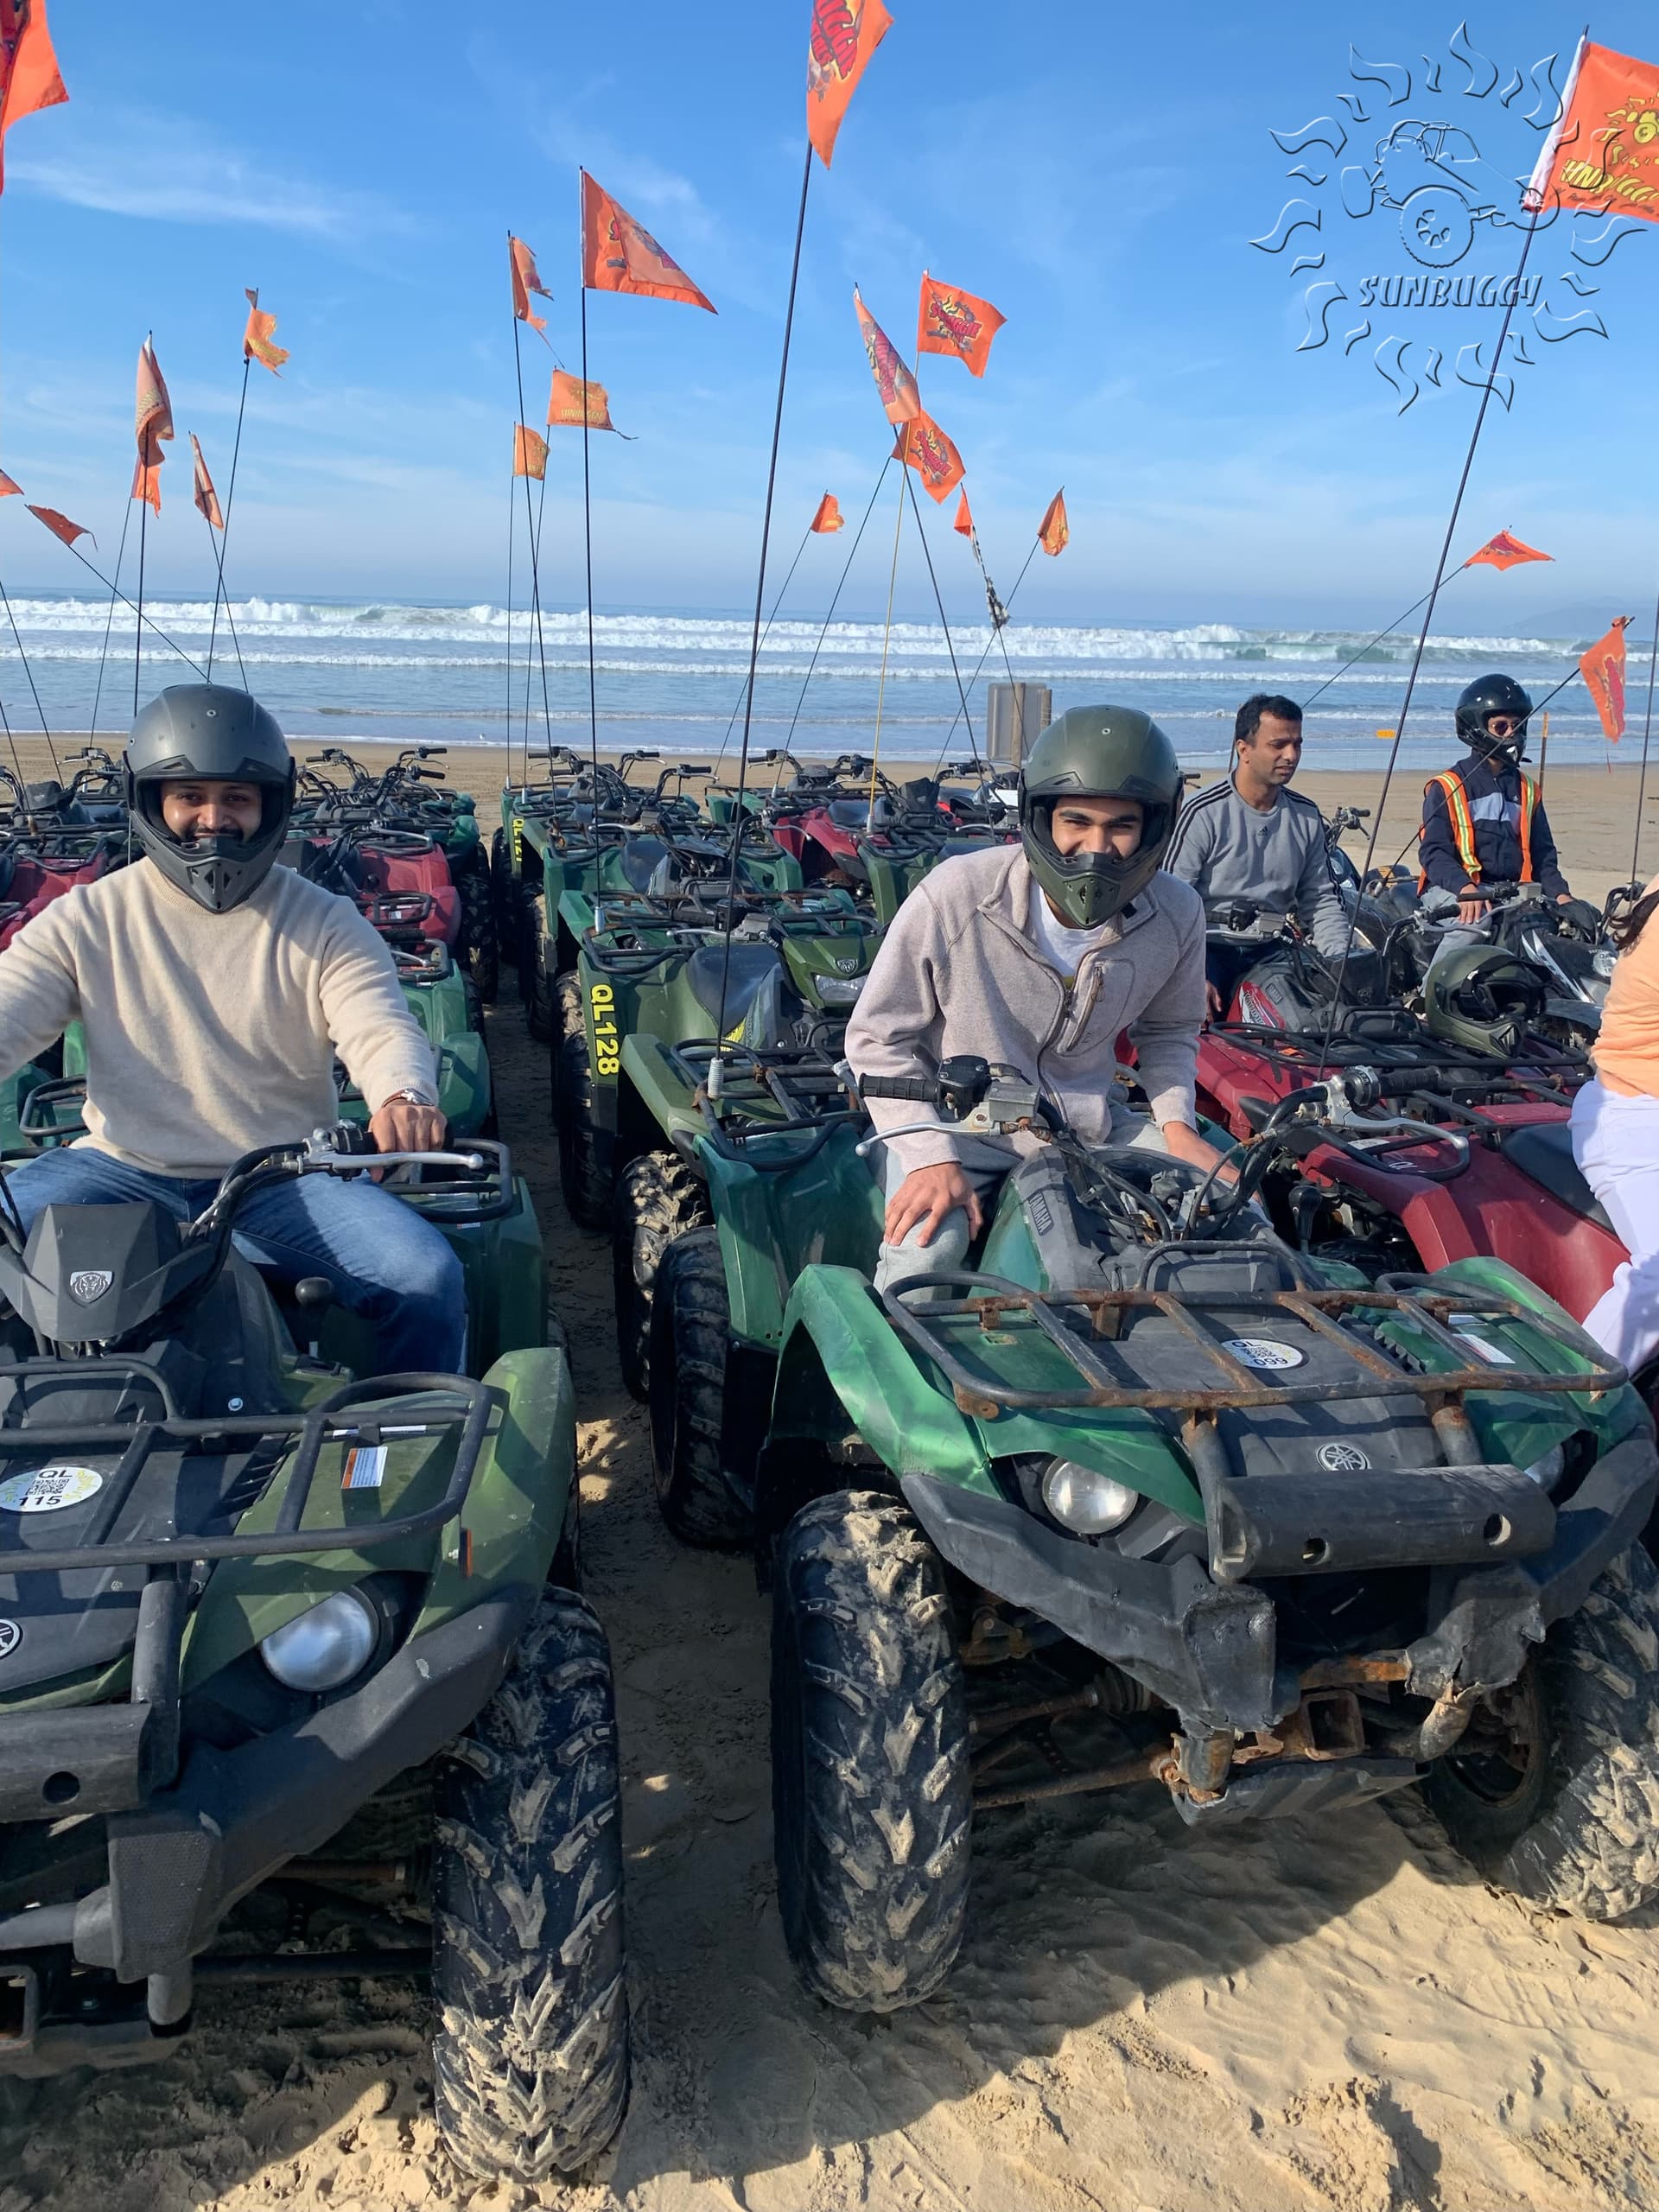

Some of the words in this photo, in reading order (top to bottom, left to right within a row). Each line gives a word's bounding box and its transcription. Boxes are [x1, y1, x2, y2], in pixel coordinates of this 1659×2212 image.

[590, 983, 620, 1076] QL128
[1253, 1357, 1288, 1366] 099
[38, 1470, 73, 1478] QL
[18, 1496, 63, 1507] 115
